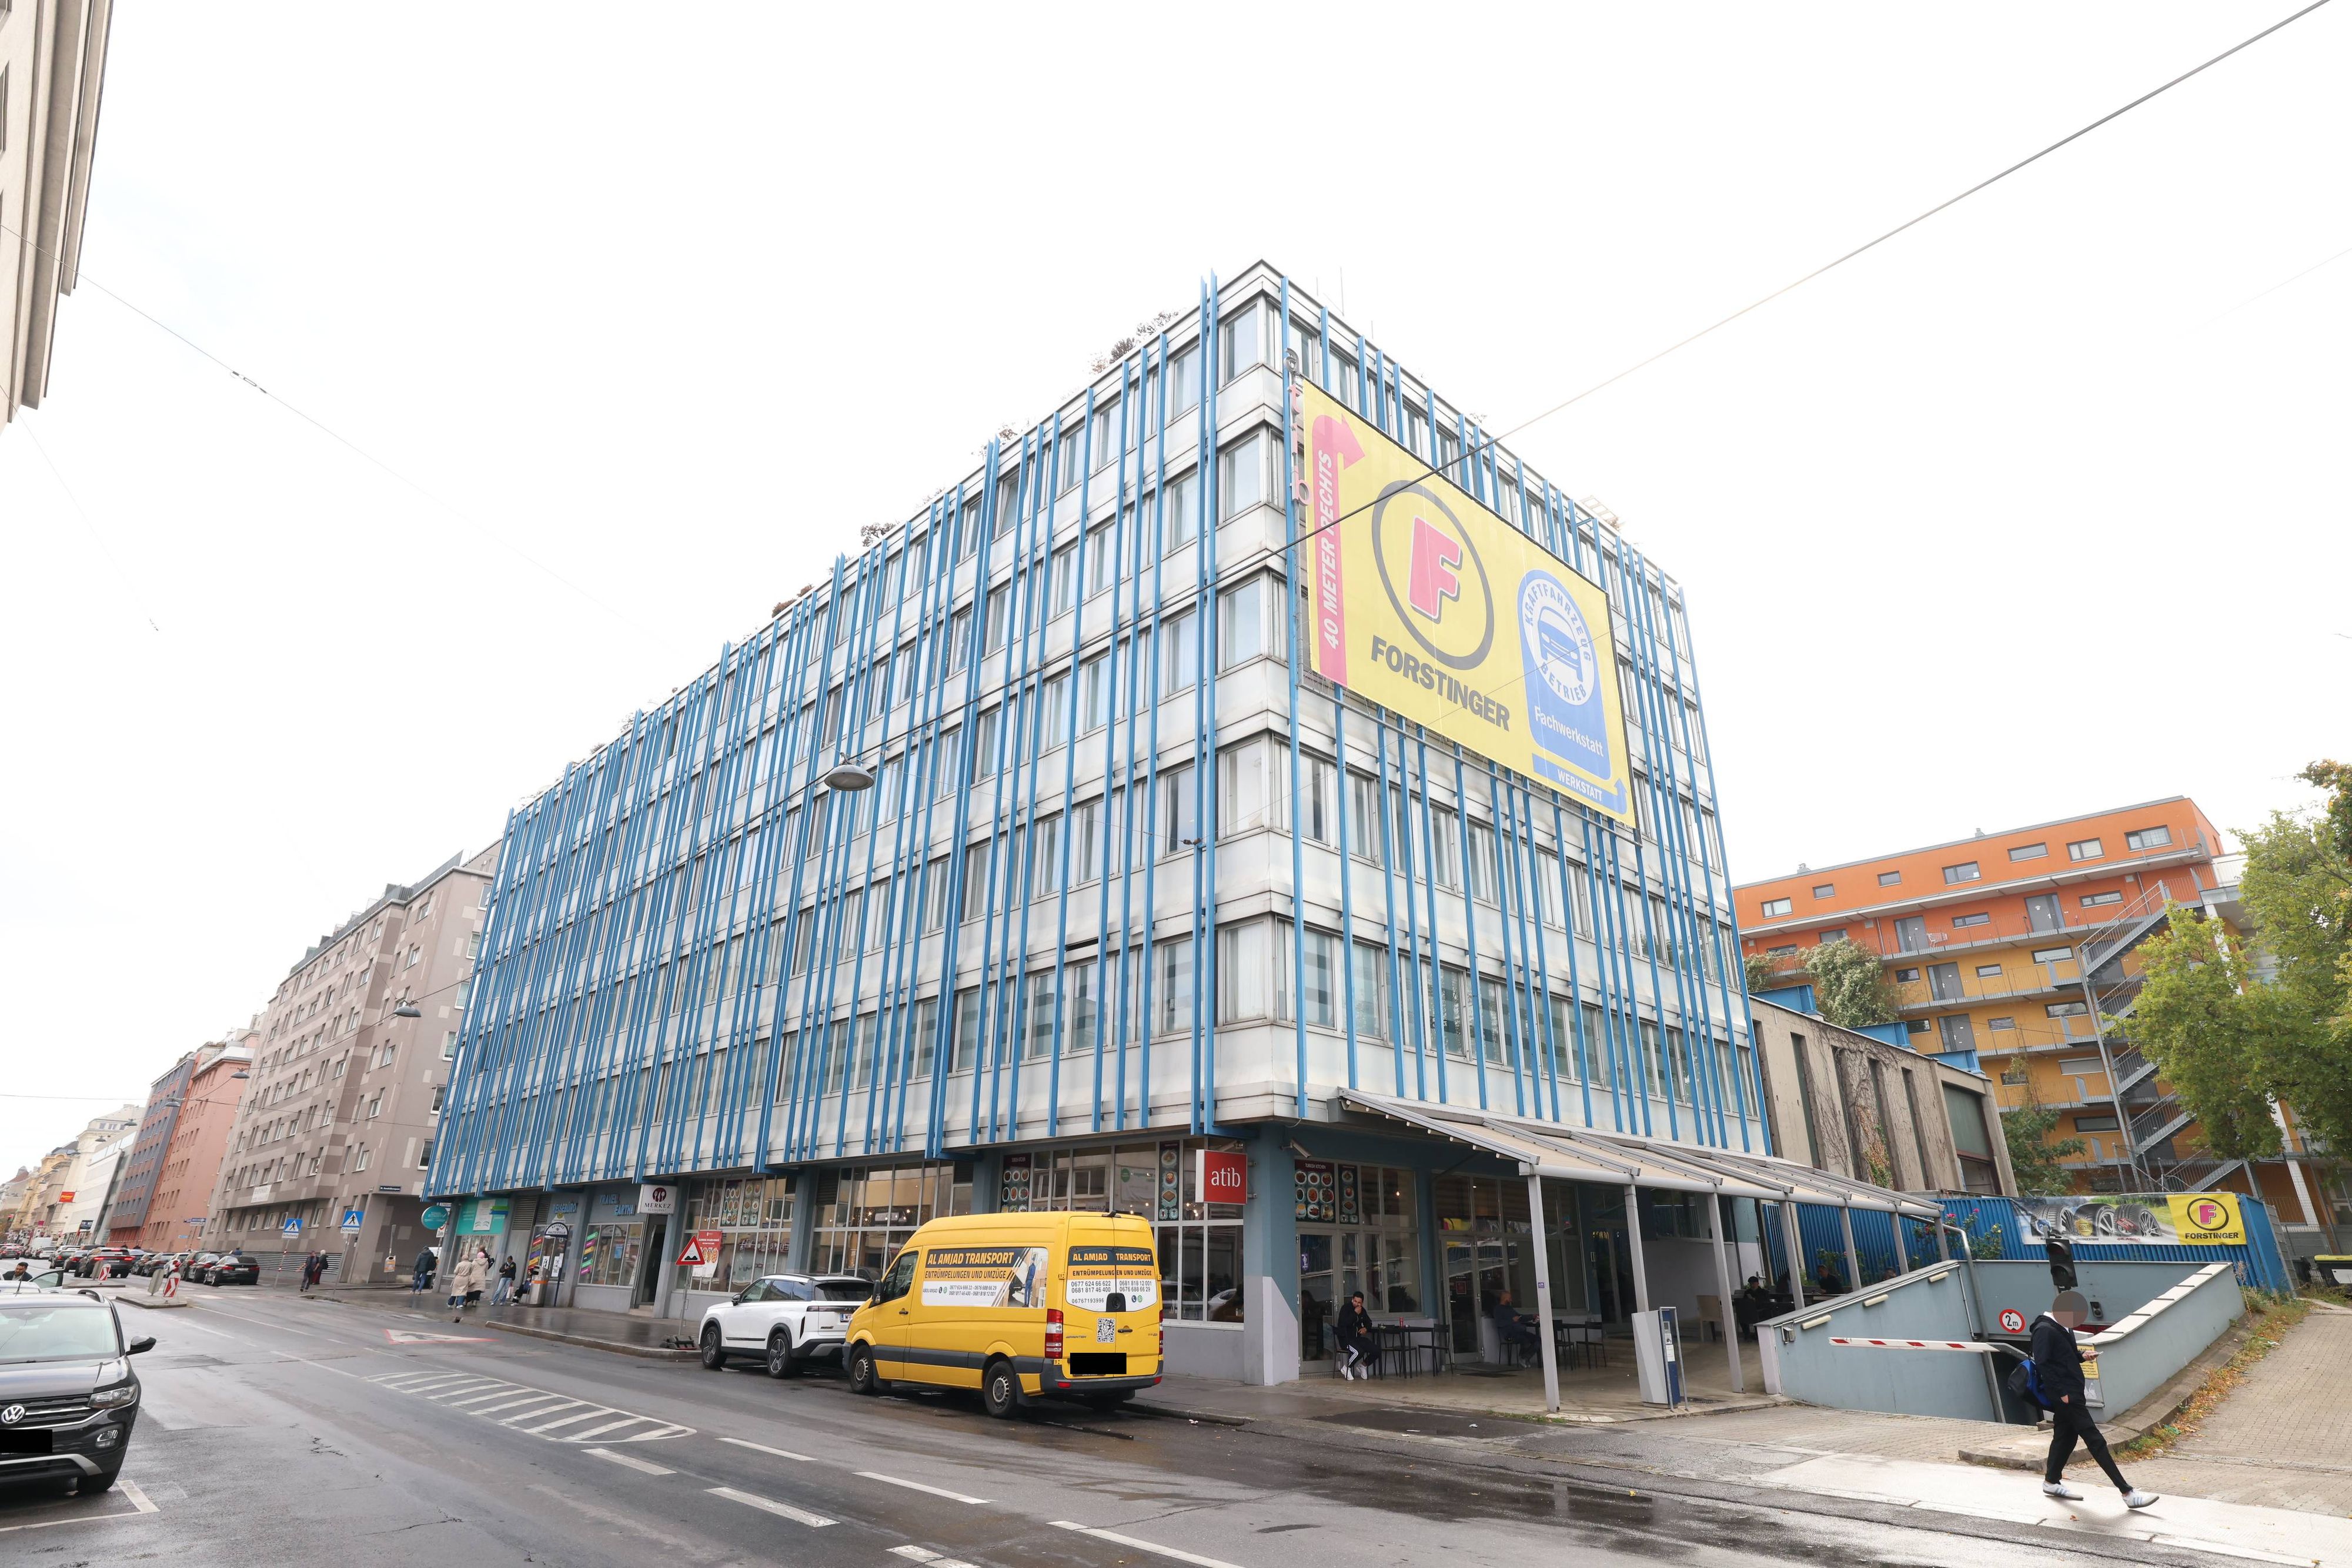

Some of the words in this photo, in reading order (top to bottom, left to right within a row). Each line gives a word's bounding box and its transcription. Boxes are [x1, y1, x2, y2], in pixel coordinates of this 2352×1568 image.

[1319, 450, 1334, 536] RECHTS
[1321, 537, 1338, 616] METER
[1409, 516, 1463, 624] F
[1324, 618, 1339, 650] 40
[1525, 583, 1591, 663] KRAFTFAHRZEUG
[1371, 634, 1510, 731] FORSTINGER
[1541, 662, 1587, 701] BETRIEB
[1534, 704, 1604, 758] Fachwerkstatt
[1557, 768, 1602, 802] WERKSTATT
[1211, 1167, 1241, 1187] atib
[2199, 1205, 2216, 1224] F
[925, 1269, 970, 1279] ENTRÜMPELUNGEN
[971, 1270, 983, 1279] UND
[984, 1268, 1006, 1279] UMZÜGE
[928, 1253, 937, 1265] AL
[938, 1253, 963, 1265] AMJAD
[965, 1252, 1014, 1265] TRANSPORT
[1084, 1253, 1108, 1262] AMJAD
[1116, 1253, 1151, 1262] TRANSPORT
